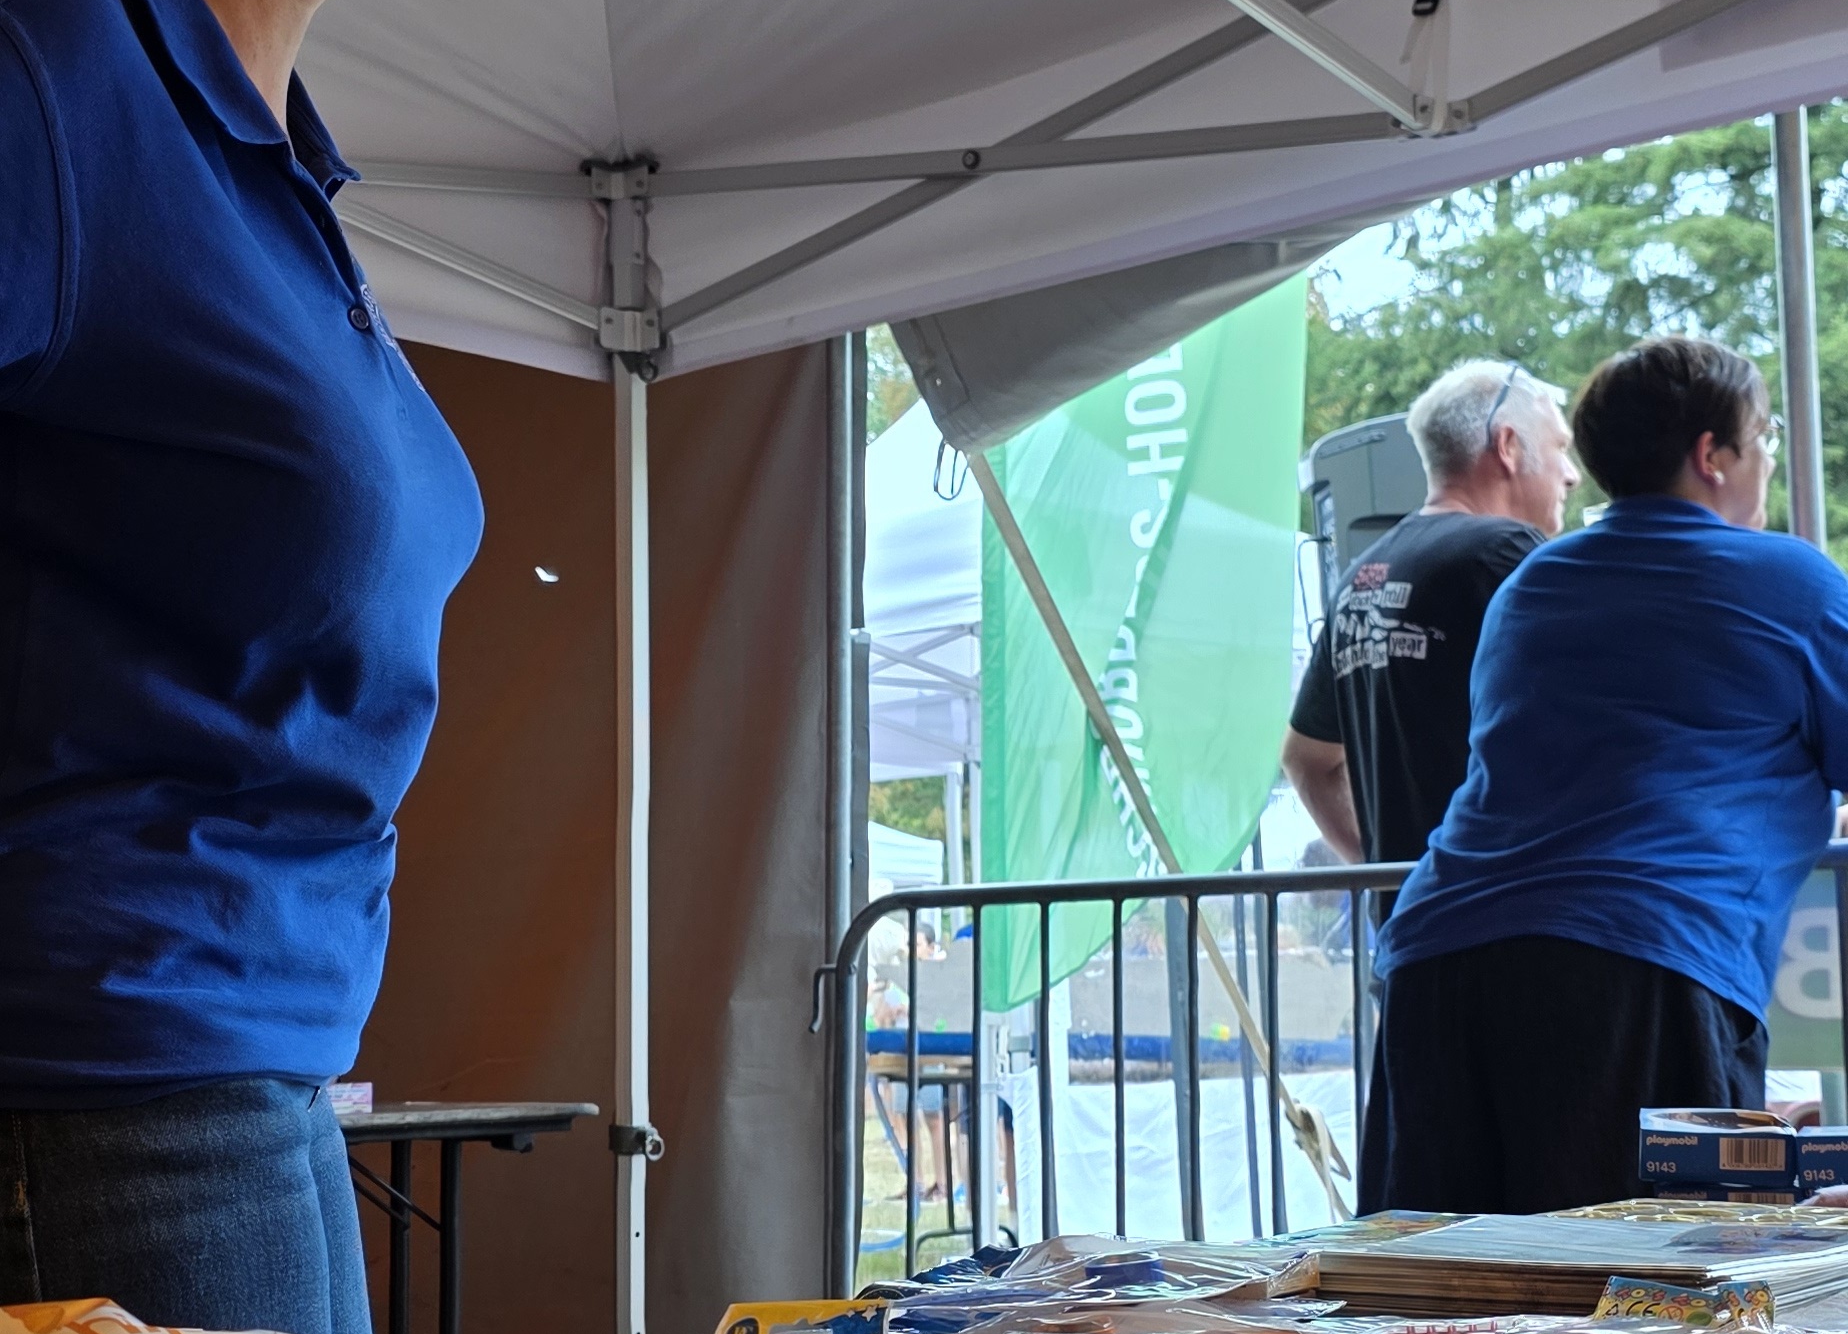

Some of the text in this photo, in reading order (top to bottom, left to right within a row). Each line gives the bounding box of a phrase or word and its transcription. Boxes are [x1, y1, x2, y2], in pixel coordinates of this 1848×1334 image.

[1391, 635, 1424, 655] year
[1645, 1135, 1699, 1147] playmobil
[1646, 1161, 1677, 1173] 9143
[1803, 1169, 1835, 1181] 9143
